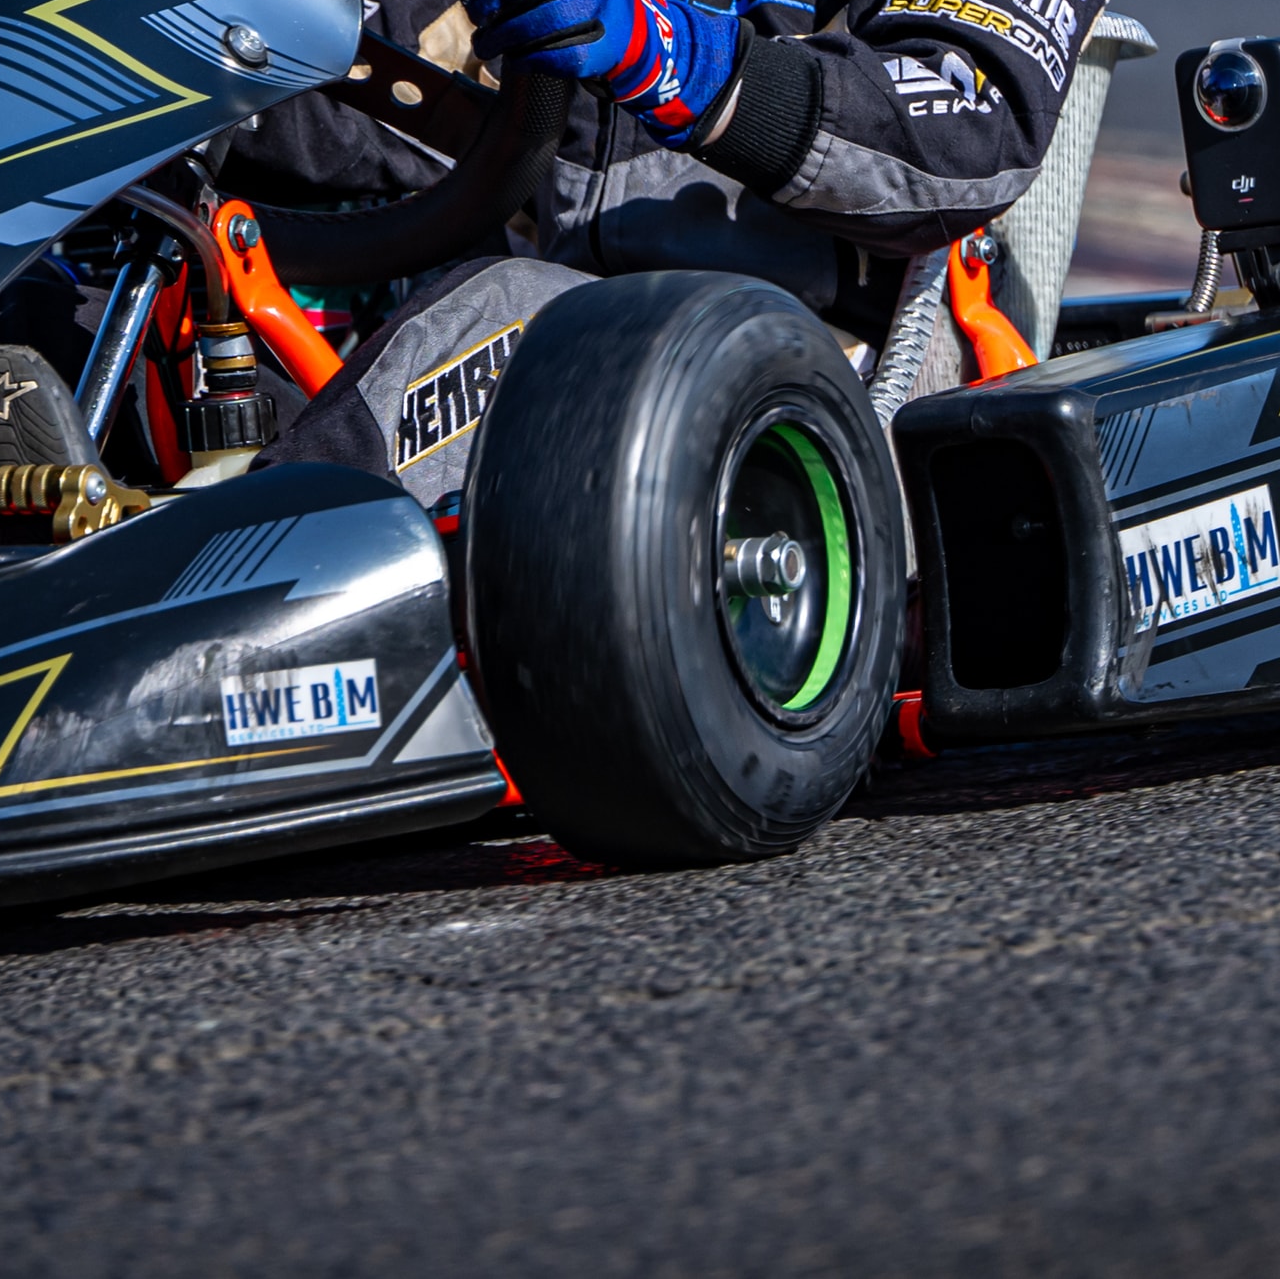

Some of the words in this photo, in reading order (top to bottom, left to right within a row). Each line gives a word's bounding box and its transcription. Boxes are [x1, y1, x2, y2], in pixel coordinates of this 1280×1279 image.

[1125, 534, 1208, 611] HWE
[1136, 601, 1199, 630] SEVCES
[1204, 590, 1228, 608] LTD
[225, 686, 304, 730] HWE
[229, 727, 295, 743] SERVICES
[300, 723, 325, 734] LTD
